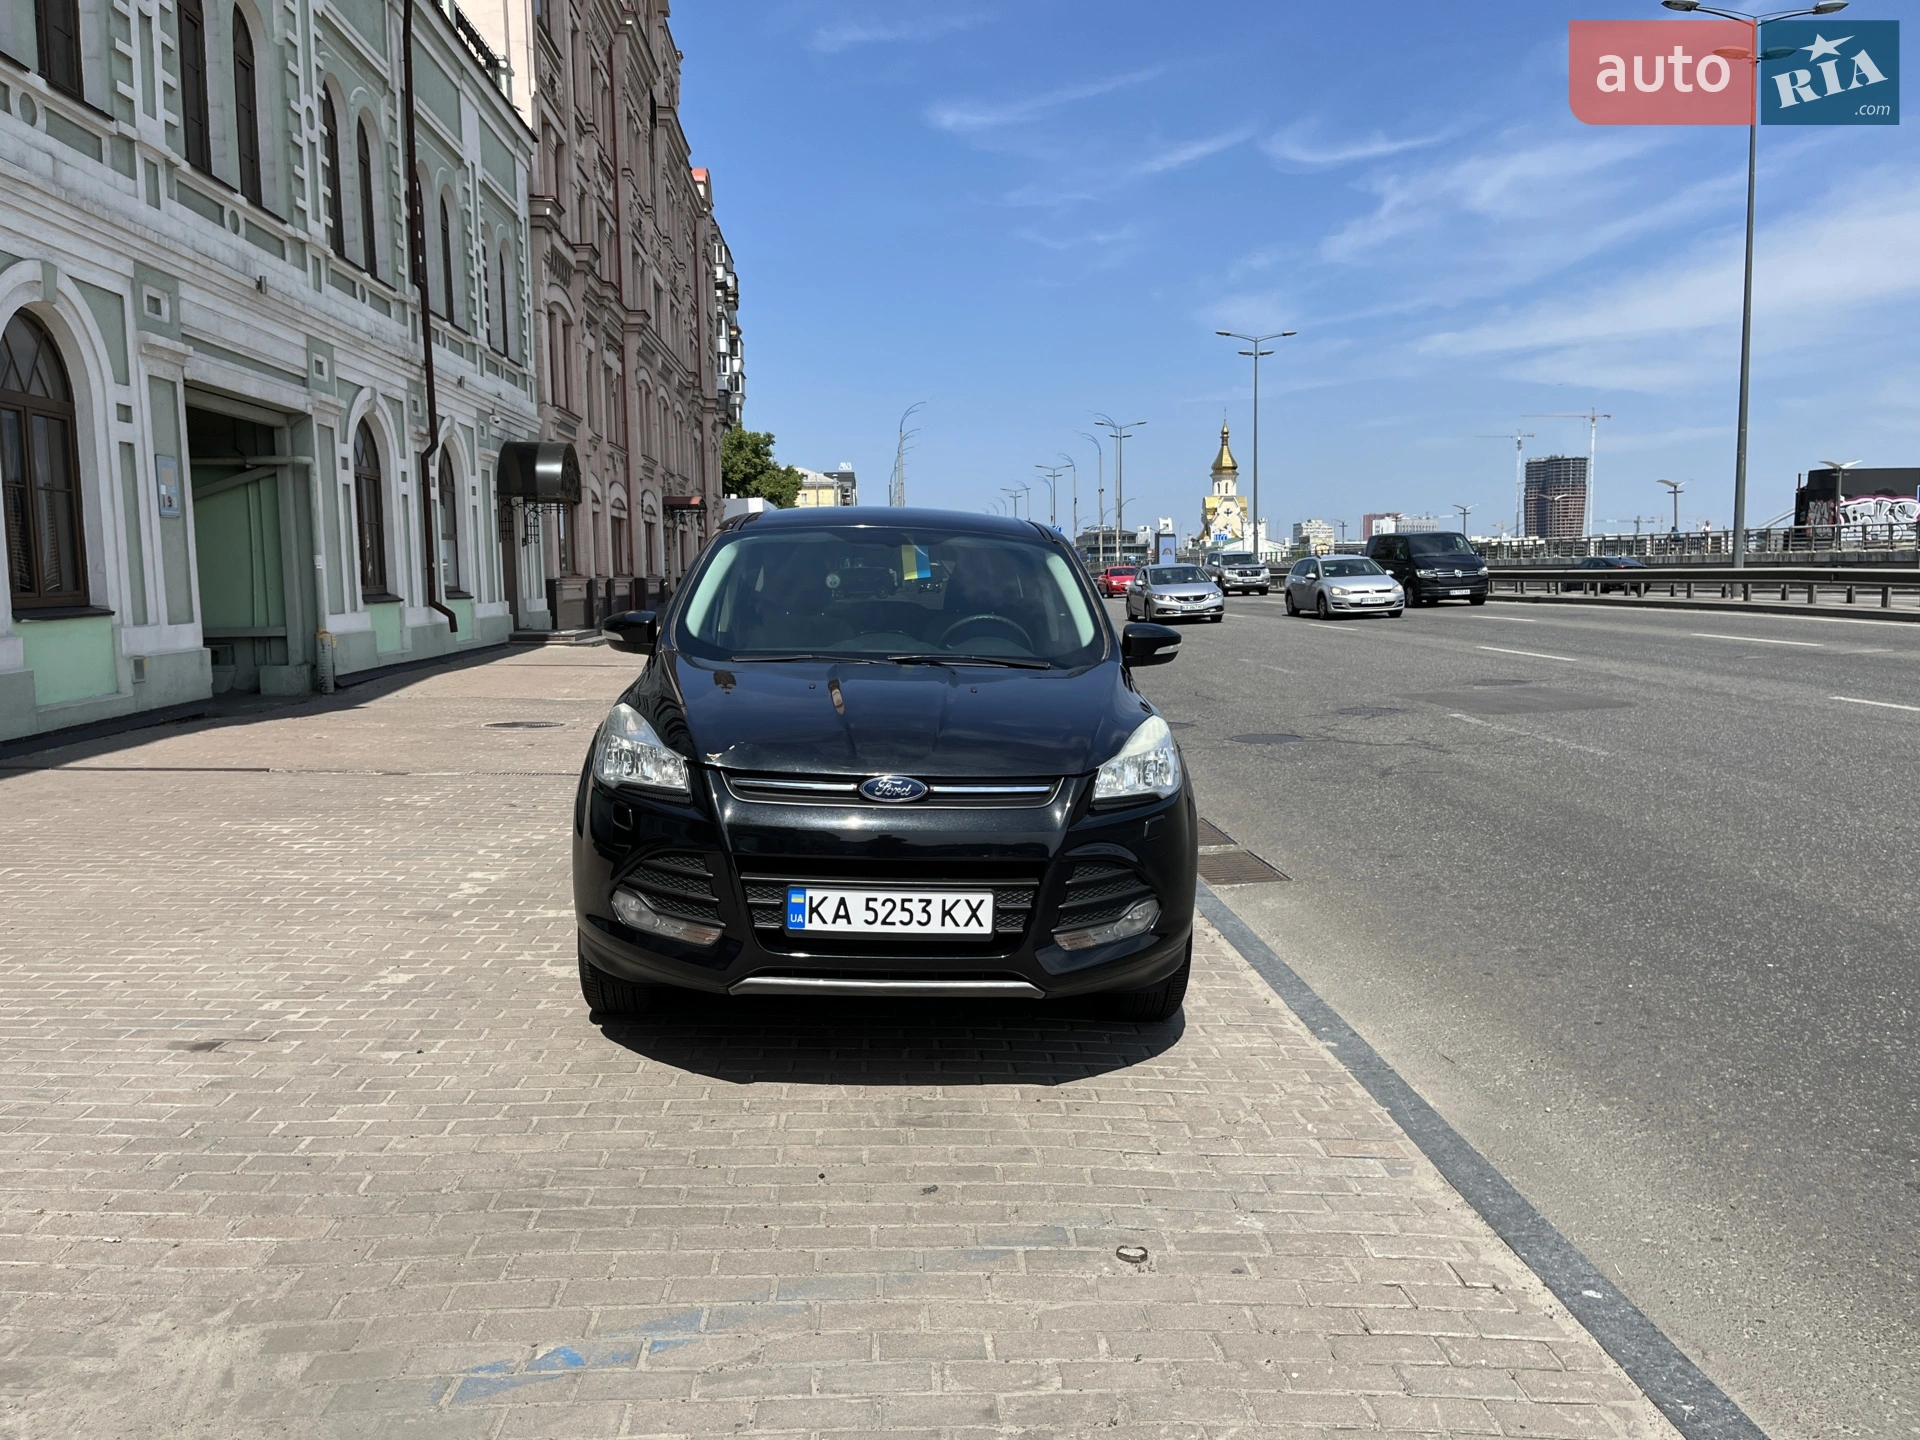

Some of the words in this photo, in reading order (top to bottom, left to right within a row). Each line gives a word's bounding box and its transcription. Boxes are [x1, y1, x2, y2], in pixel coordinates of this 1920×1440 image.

[874, 779, 912, 796] Ford
[790, 913, 804, 923] UA
[807, 896, 852, 925] KA
[863, 897, 932, 927] 5253
[940, 898, 985, 928] KX
